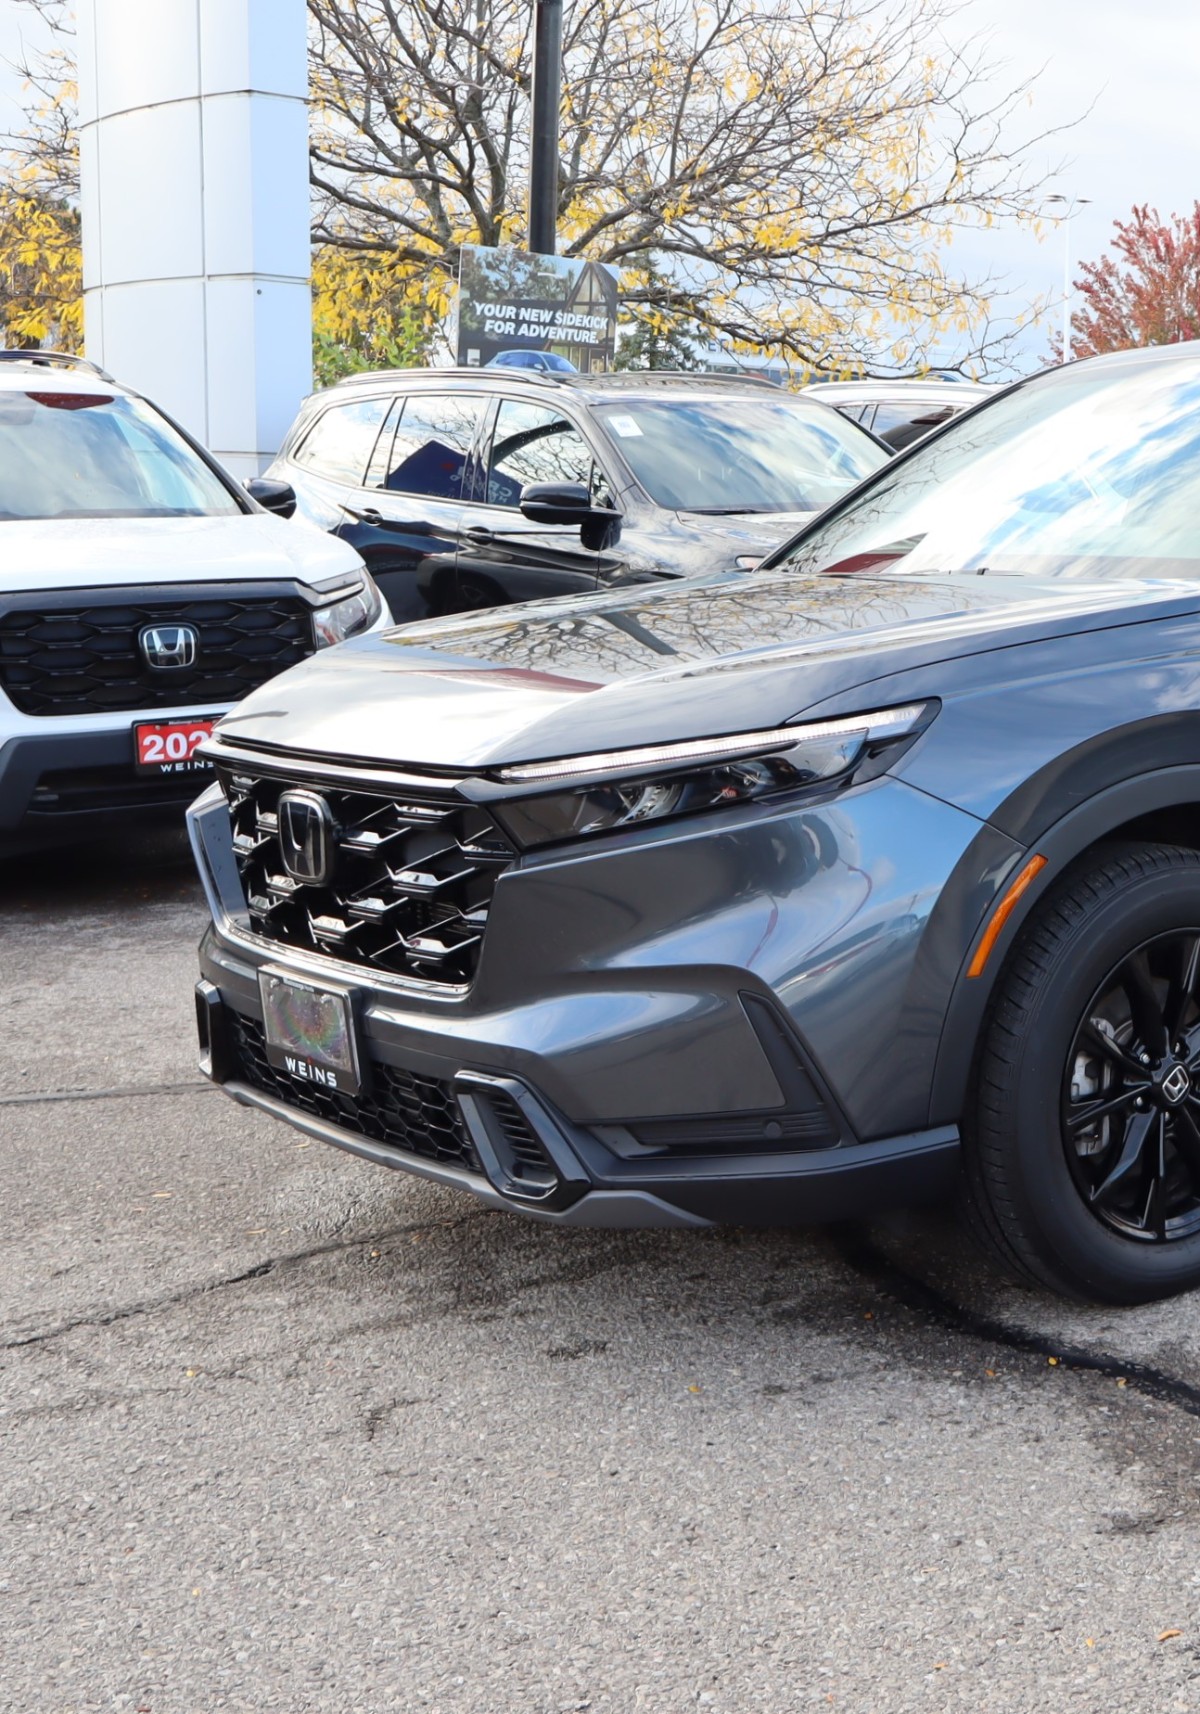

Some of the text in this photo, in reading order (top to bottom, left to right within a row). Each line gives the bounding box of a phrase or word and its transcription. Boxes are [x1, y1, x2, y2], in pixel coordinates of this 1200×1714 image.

[473, 301, 609, 331] YOUR NEW SIDEKICK
[484, 319, 600, 344] FOR ADVENTURE.
[142, 731, 211, 762] 202
[284, 1055, 338, 1087] WEINS
